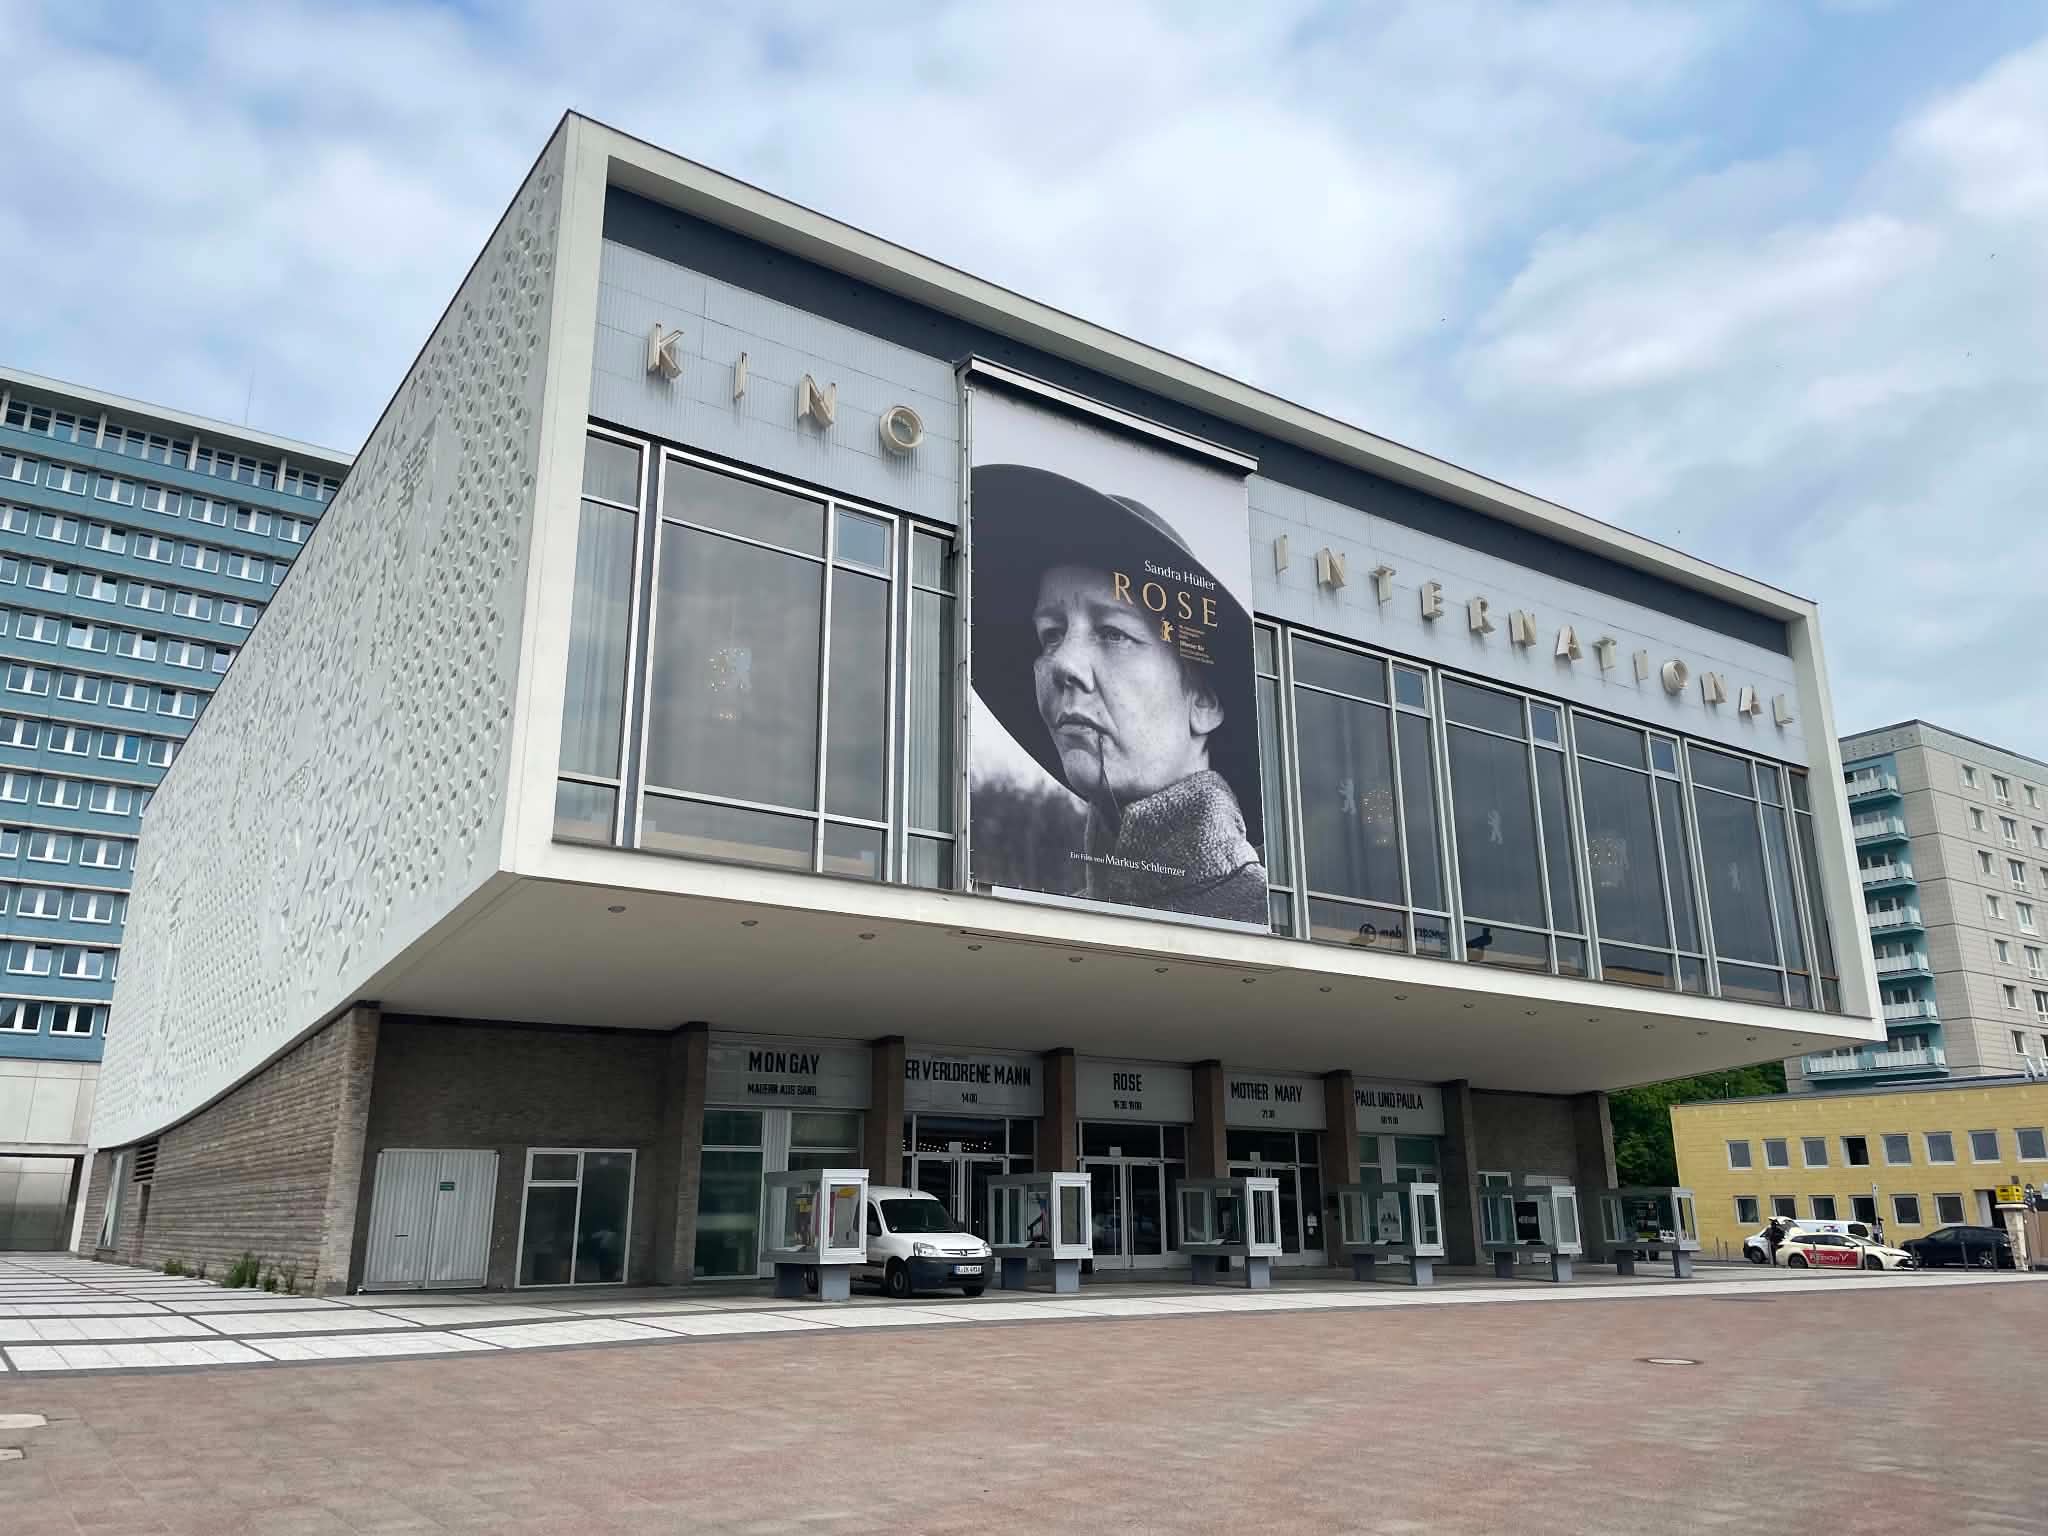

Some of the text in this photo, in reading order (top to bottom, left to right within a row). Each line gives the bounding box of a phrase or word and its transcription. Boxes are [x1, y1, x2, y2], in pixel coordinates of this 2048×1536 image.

[647, 322, 926, 457] KINO
[1144, 559, 1216, 591] Sandra Hüller
[1112, 571, 1218, 628] ROSE
[1274, 533, 1795, 728] INTERNATIONAL
[1105, 854, 1140, 870] Markus
[1141, 860, 1186, 877] Schleinzer
[922, 1060, 991, 1084] VERLORENE
[993, 1065, 1032, 1087] MANN
[1112, 1072, 1143, 1092] ROSE
[1231, 1080, 1303, 1104] MOTHER MARY
[1354, 1089, 1377, 1107] PAUL
[1395, 1092, 1424, 1110] PAULA
